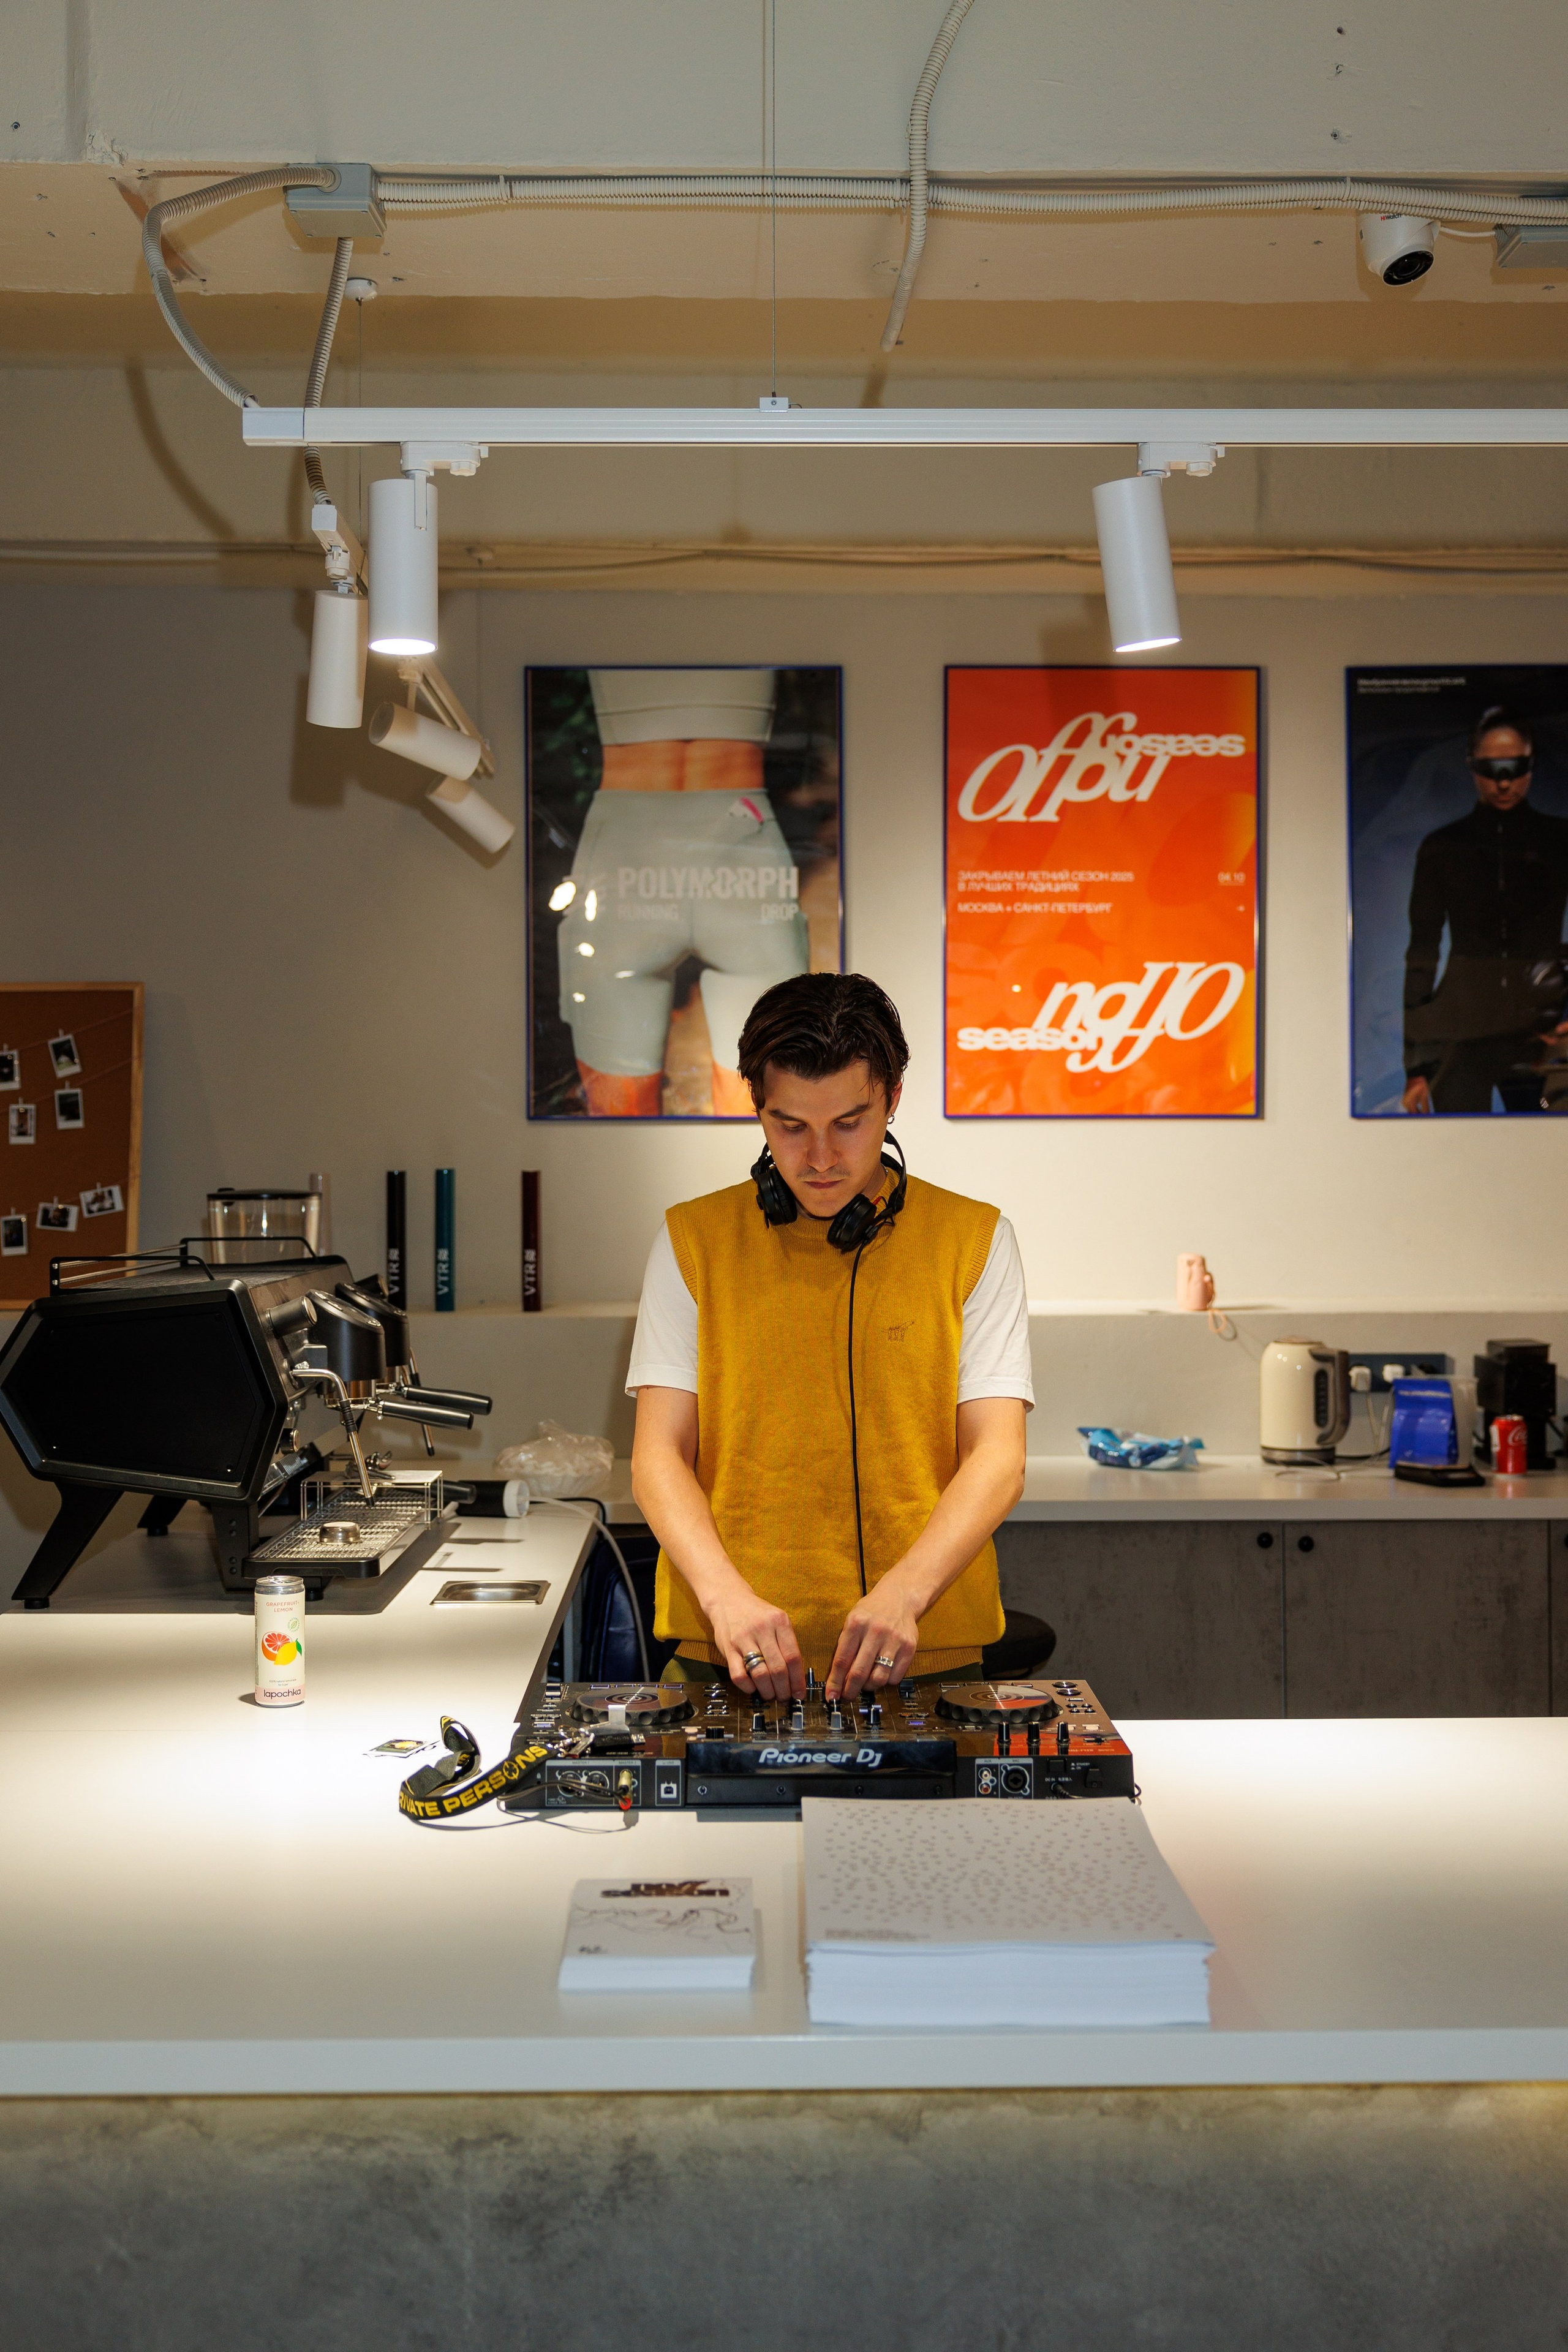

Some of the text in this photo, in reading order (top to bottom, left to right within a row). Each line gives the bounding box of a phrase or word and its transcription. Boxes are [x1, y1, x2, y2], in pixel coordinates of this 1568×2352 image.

[958, 870, 1025, 881] ЗАКРЫВАЕМ
[1027, 869, 1070, 881] ЛЕТНИЙ
[1071, 871, 1110, 882] СЕЗОН
[617, 867, 799, 899] POLYMORPH
[958, 882, 1080, 892] В ЛУЧШИХ ТРАДИЦИЯХ
[761, 903, 799, 921] DROP
[957, 902, 1113, 913] МОСКВА САНКТ-ПЕТЕРБУРГ
[263, 1689, 301, 1700] lapochka
[759, 1747, 851, 1763] Pioneer
[399, 1791, 441, 1817] RIVATE
